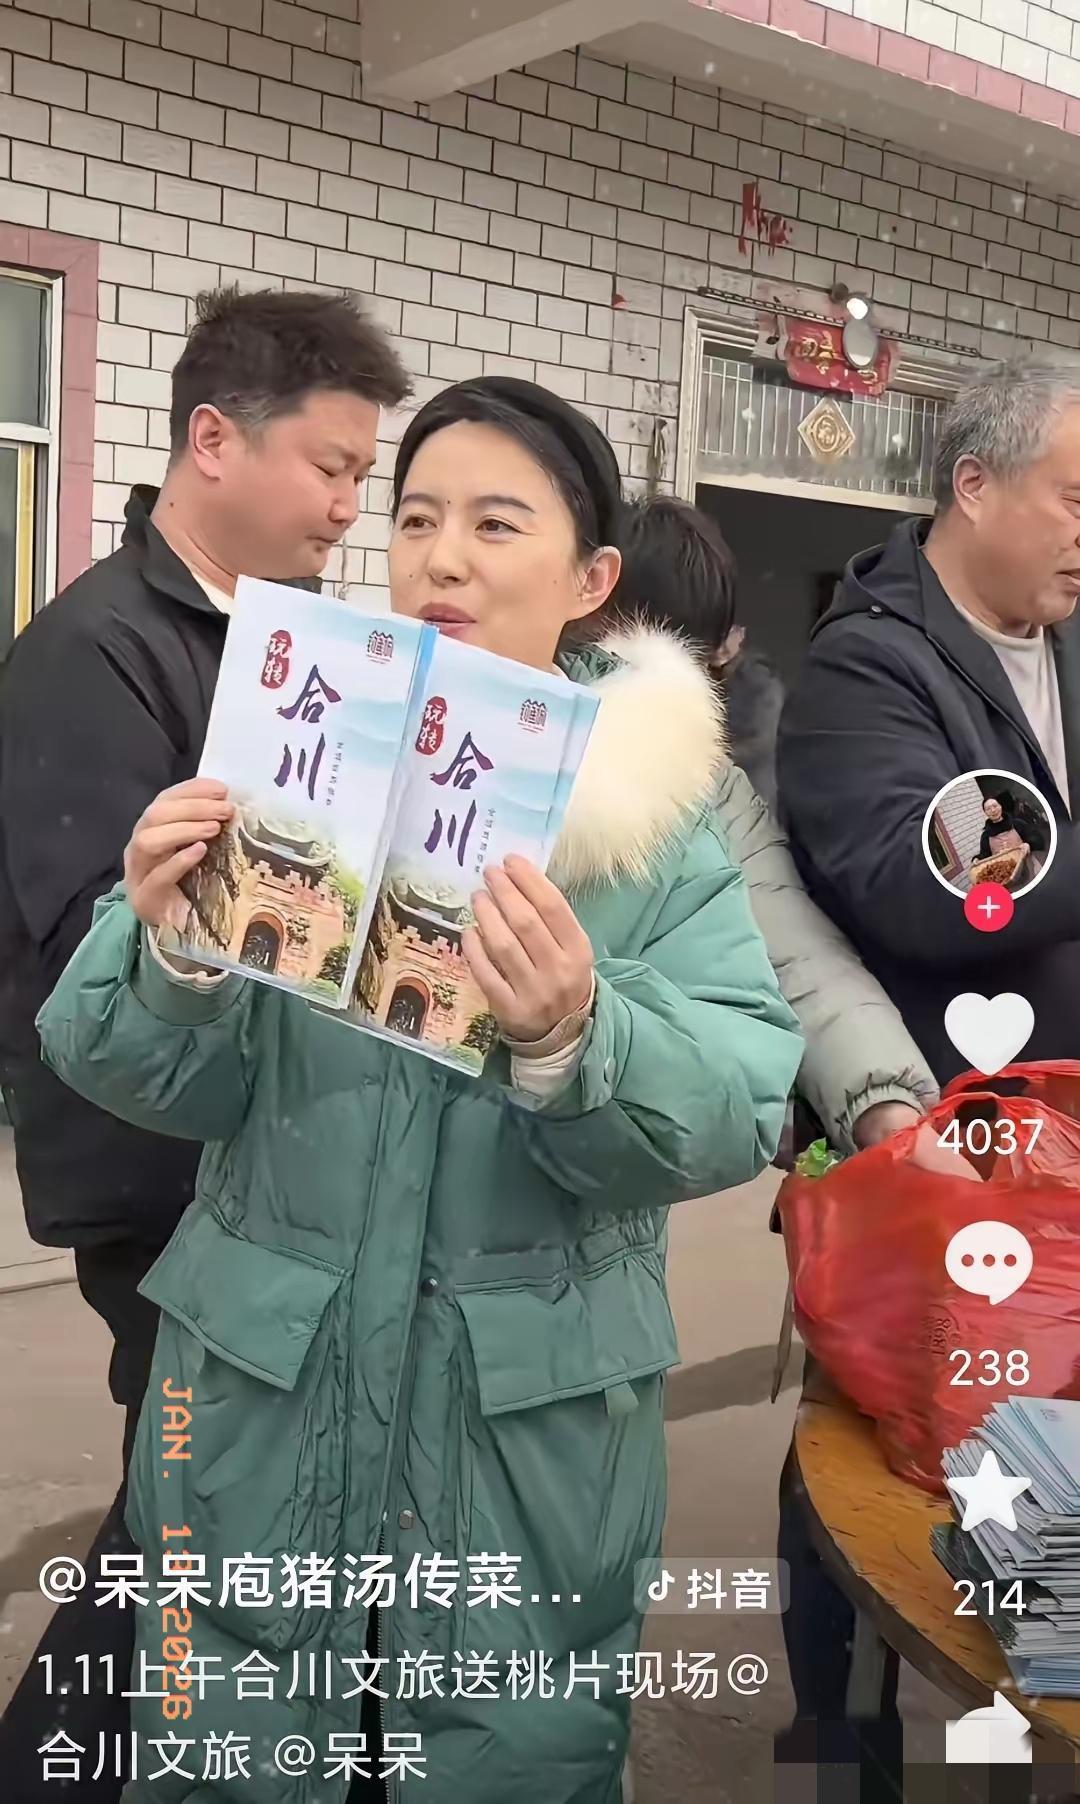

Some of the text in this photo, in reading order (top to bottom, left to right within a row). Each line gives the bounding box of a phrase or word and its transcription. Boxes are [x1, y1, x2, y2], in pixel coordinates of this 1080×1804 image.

[264, 636, 290, 685] 玩转
[274, 664, 342, 801] 合川
[418, 703, 447, 751] 玩转
[424, 732, 494, 867] 合川
